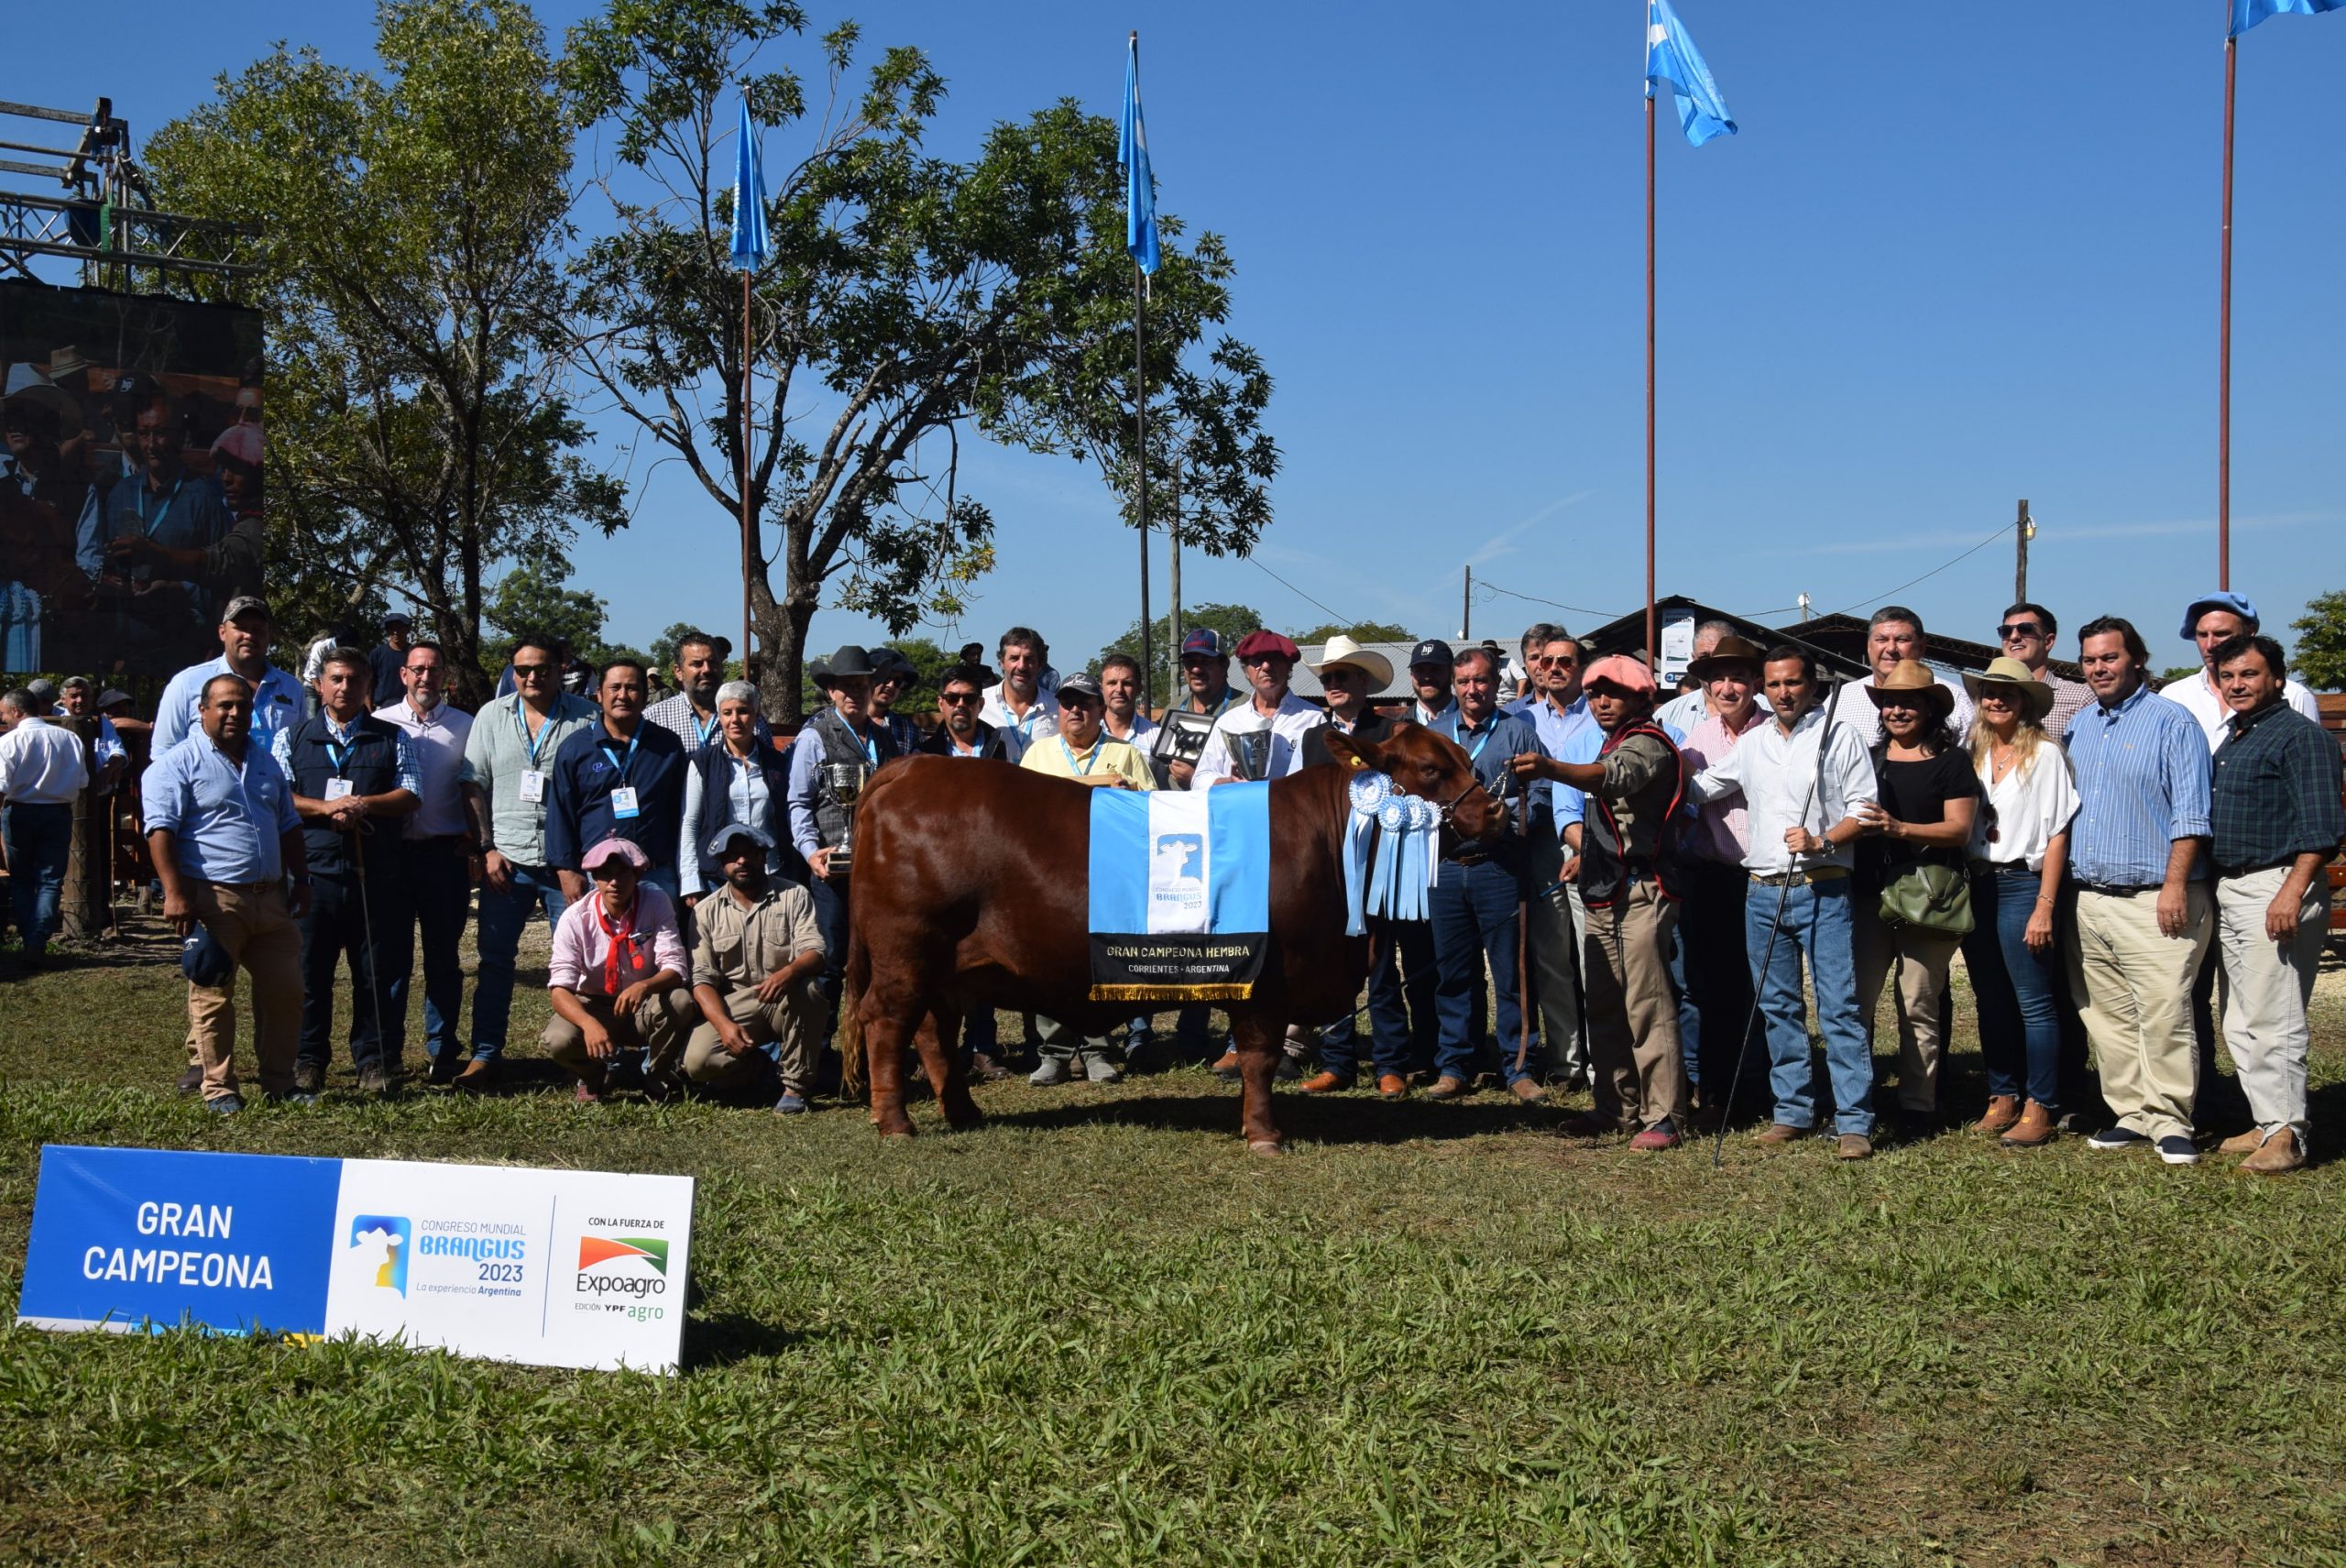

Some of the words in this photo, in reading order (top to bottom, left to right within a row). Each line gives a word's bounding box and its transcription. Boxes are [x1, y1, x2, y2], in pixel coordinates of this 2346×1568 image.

[1156, 893, 1202, 902] BRANGUS
[1183, 901, 1202, 909] 2023
[1106, 946, 1138, 957] GRAN
[1141, 947, 1202, 959] CAMPEONA
[1206, 946, 1250, 959] HEMBRA
[1128, 964, 1179, 974] CORRIENTES
[1185, 964, 1230, 974] ARGENTINA
[137, 1201, 232, 1239] GRAN
[422, 1220, 477, 1234] CONGRESO
[480, 1223, 526, 1236] MUNDIAL
[588, 1217, 606, 1226] CON
[608, 1218, 618, 1227] LA
[619, 1219, 652, 1229] FUERZA
[653, 1221, 664, 1229] DE
[420, 1235, 525, 1262] BRANGUS
[83, 1246, 273, 1290] CAMPEONA
[478, 1263, 523, 1282] 2023
[416, 1282, 427, 1291] La
[428, 1283, 477, 1294] experiencia
[477, 1286, 521, 1298] Argentina
[576, 1273, 665, 1299] Expoagro
[575, 1302, 601, 1311] EDICIÓN
[605, 1304, 626, 1312] YPF
[628, 1305, 663, 1322] agro
